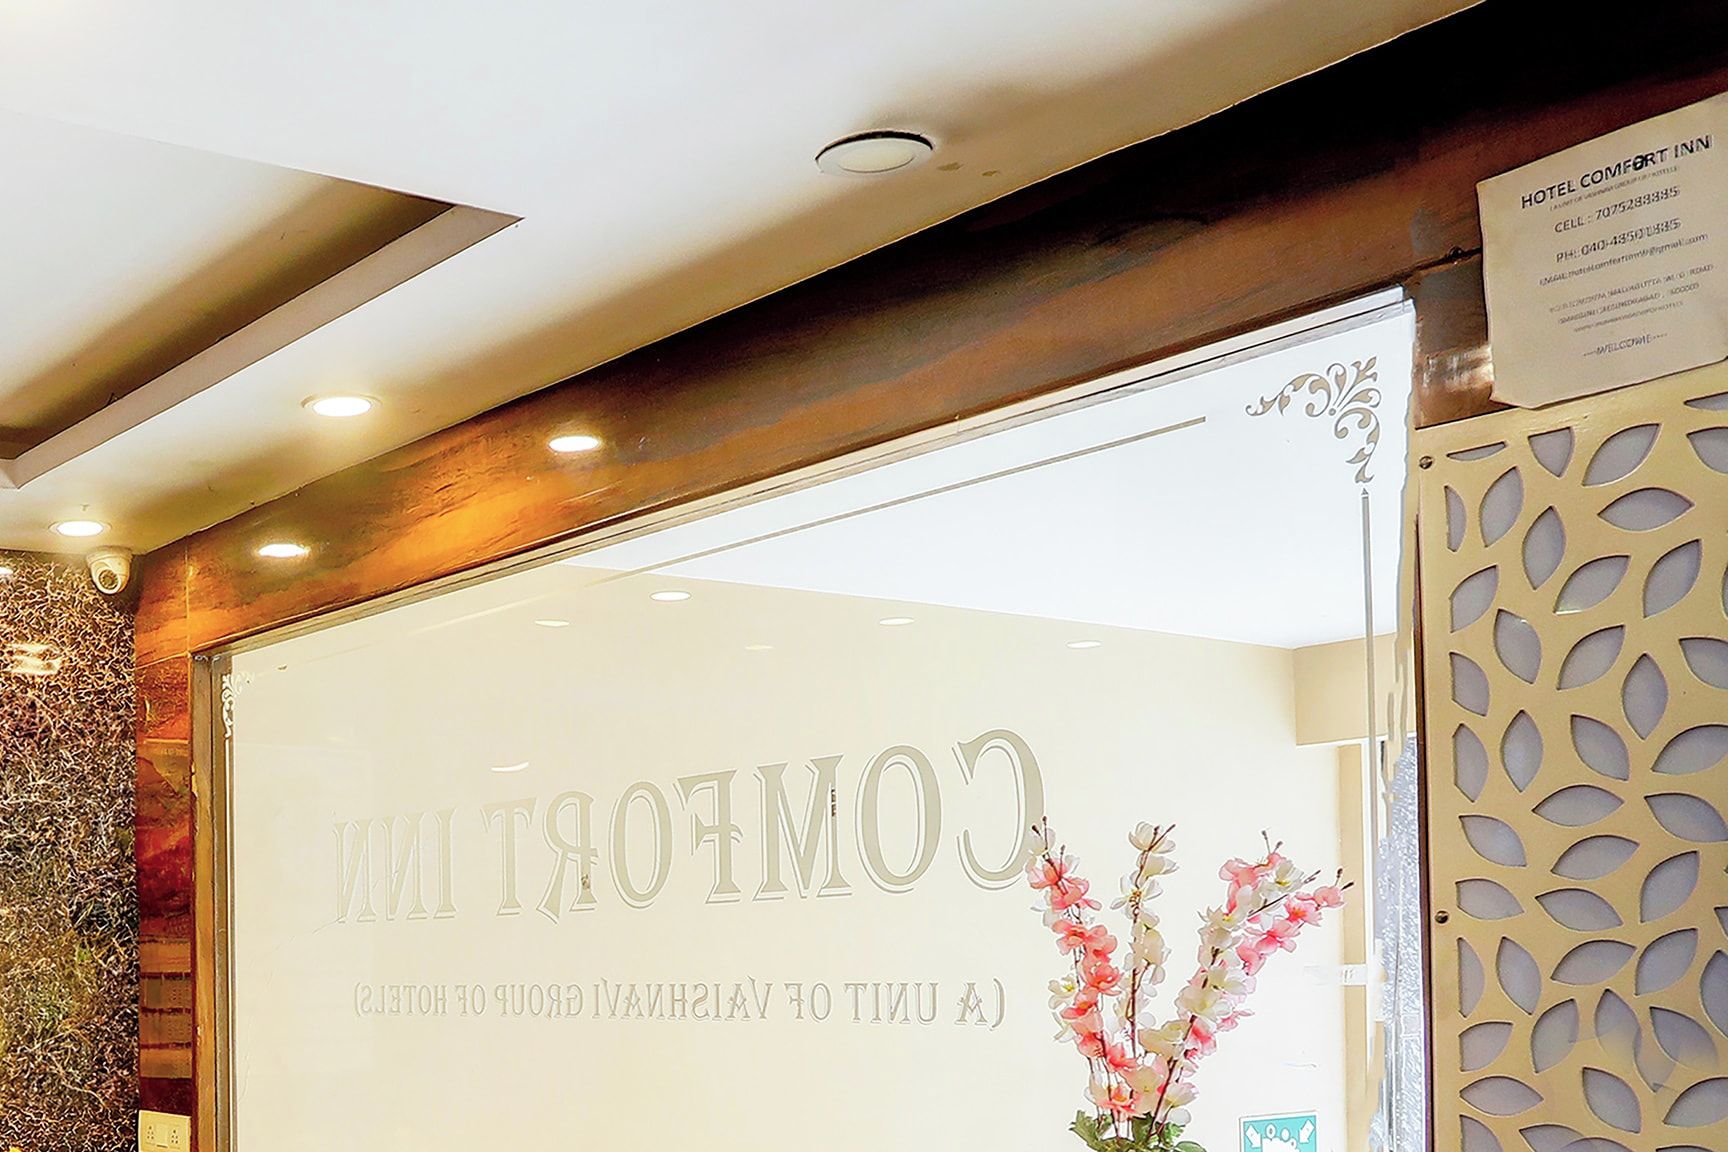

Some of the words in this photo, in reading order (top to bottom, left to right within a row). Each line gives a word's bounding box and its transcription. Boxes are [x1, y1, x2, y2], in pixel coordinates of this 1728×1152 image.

[1521, 180, 1576, 209] HOTEL
[1580, 148, 1668, 188] COMFORT
[1674, 135, 1711, 158] INN
[1555, 216, 1584, 233] CELL
